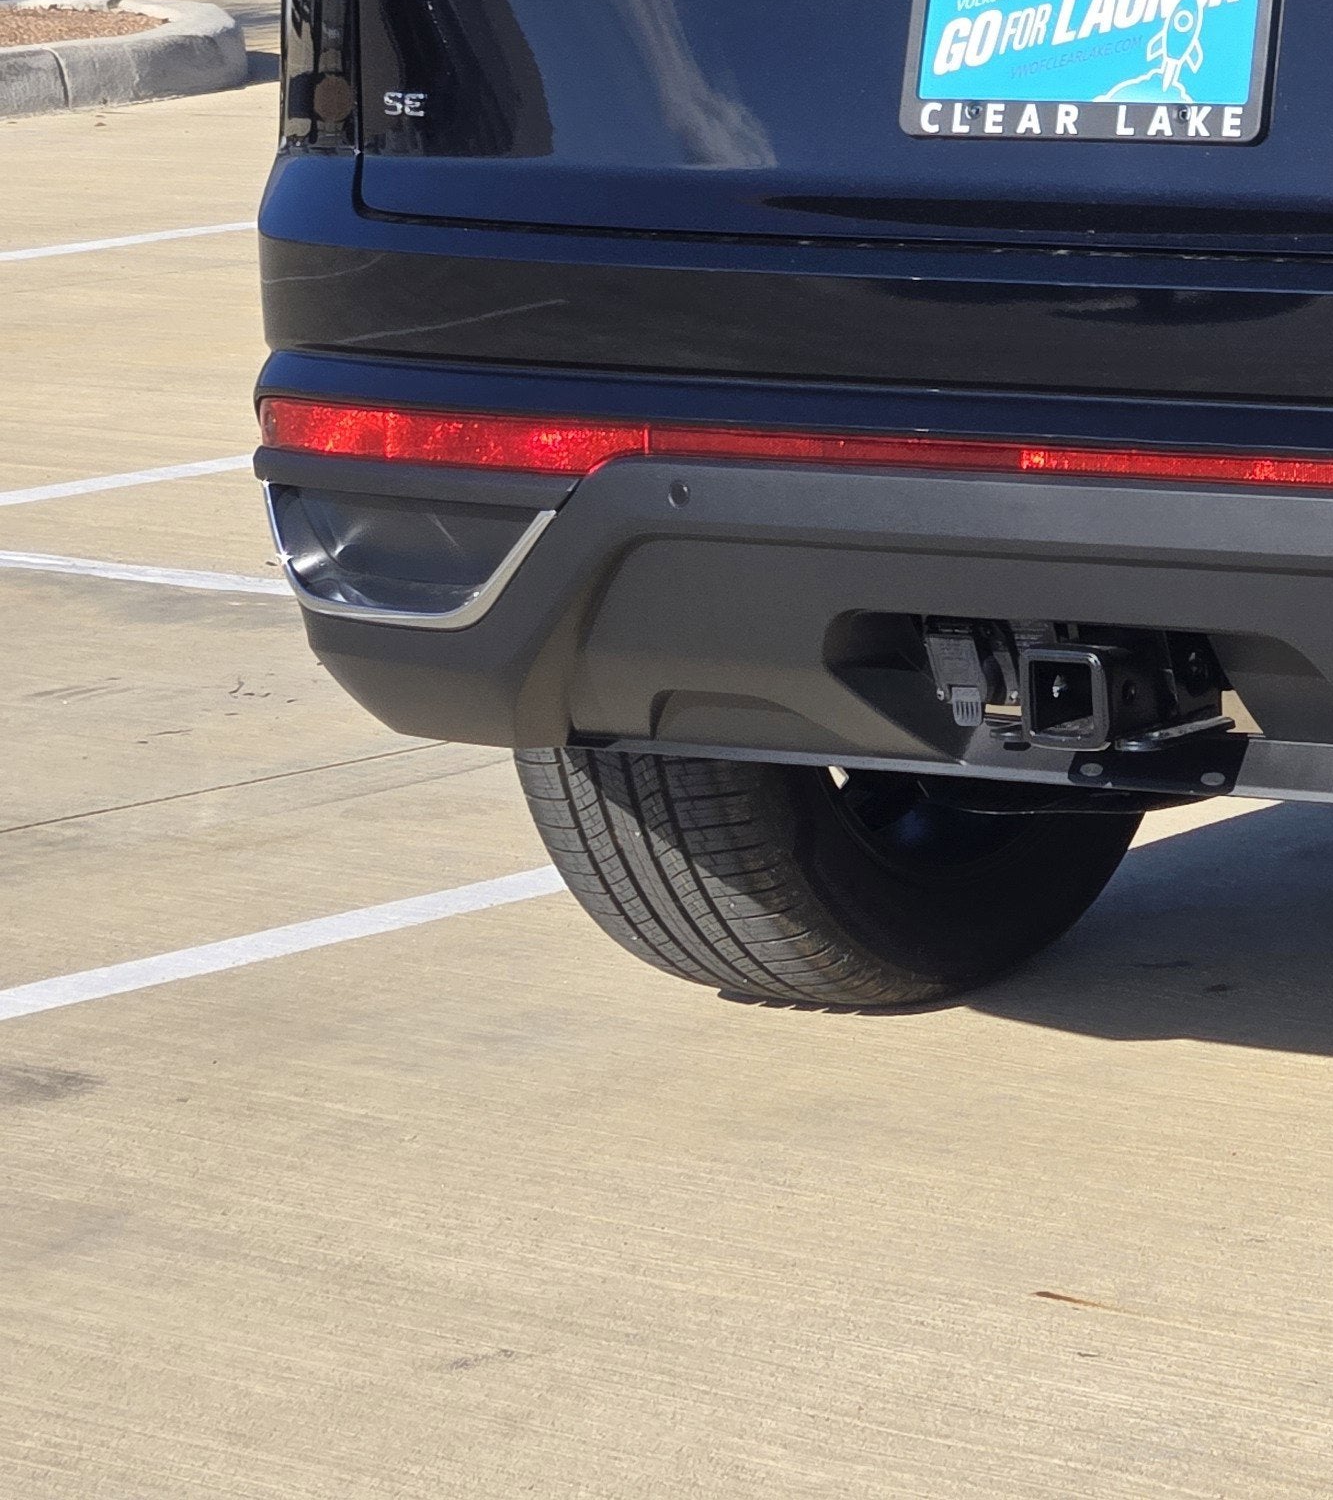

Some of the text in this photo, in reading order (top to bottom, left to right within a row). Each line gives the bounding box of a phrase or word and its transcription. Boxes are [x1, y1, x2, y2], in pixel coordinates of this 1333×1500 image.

[932, 8, 1003, 77] GO
[999, 3, 1053, 56] FOR
[383, 91, 425, 117] SE
[919, 102, 1244, 137] CLEAR LAKE
